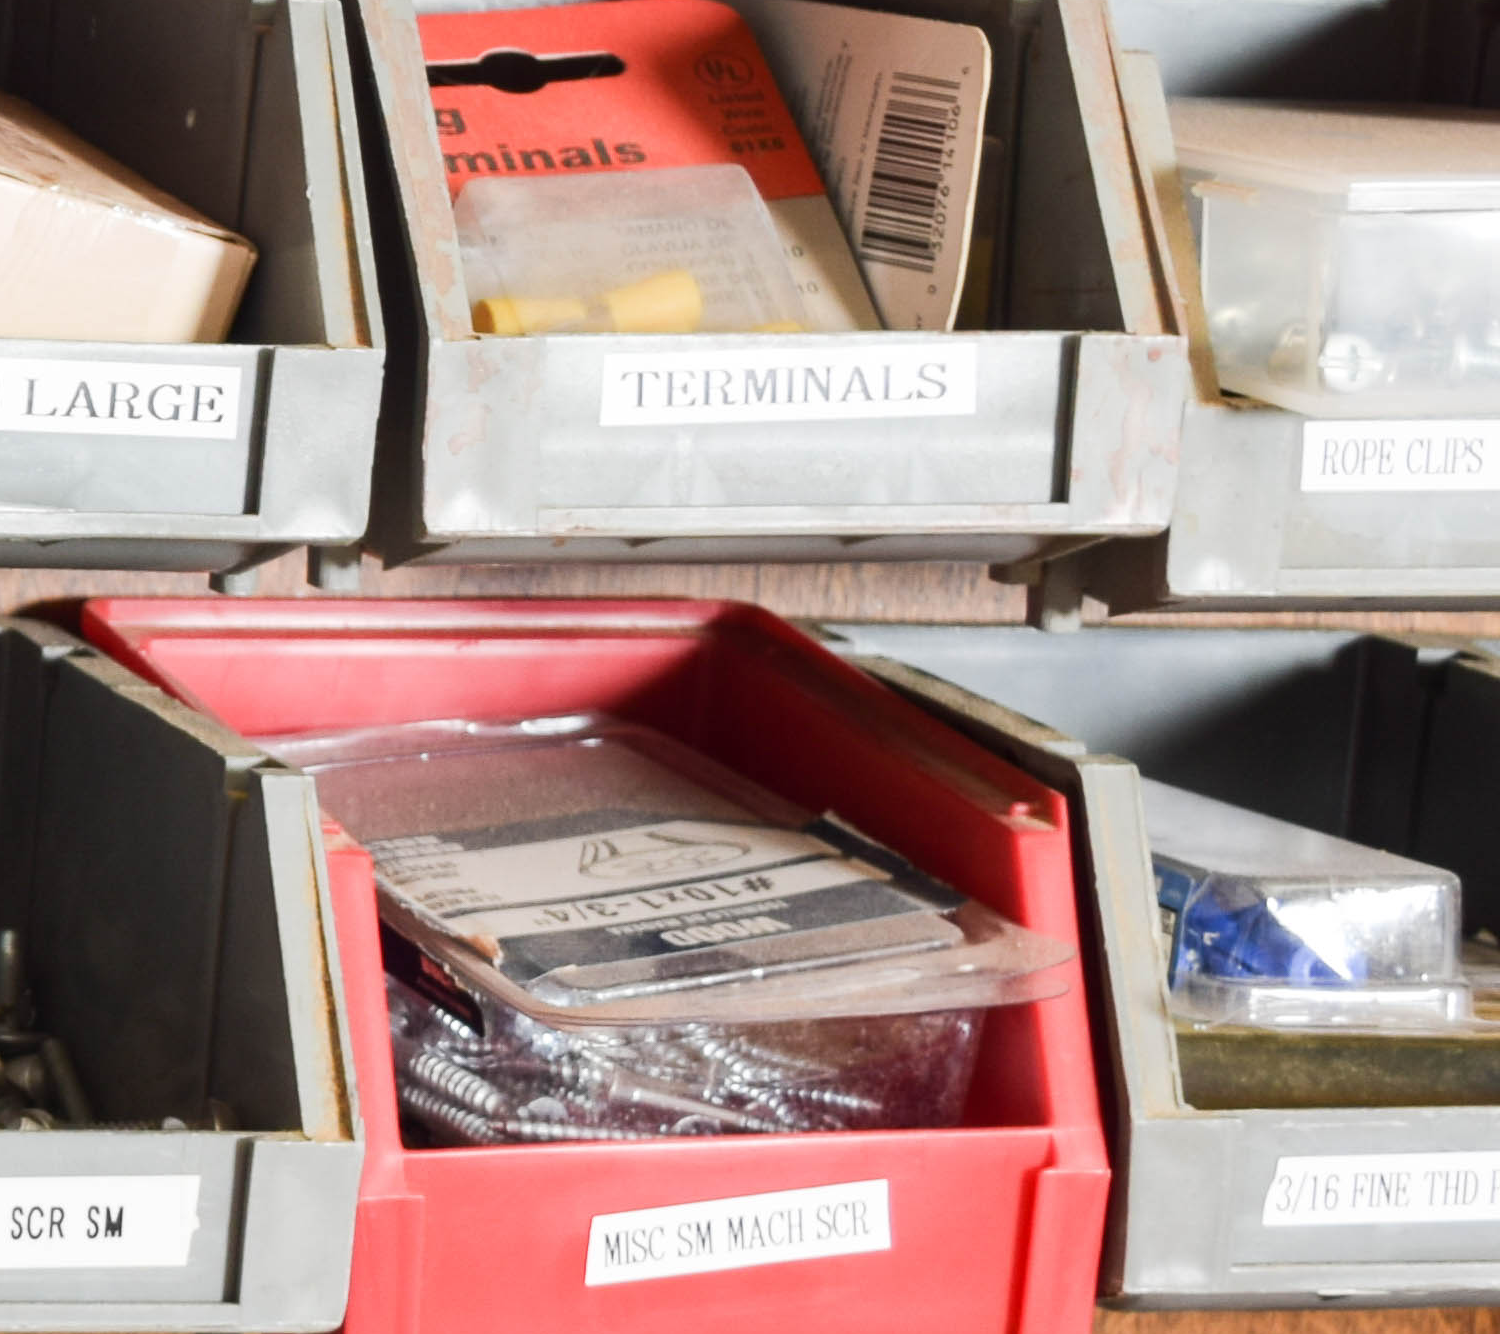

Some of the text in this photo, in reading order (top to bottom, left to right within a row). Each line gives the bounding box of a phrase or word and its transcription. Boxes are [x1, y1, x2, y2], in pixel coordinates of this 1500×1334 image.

[25, 378, 224, 423] LARGE
[620, 363, 948, 408] TERMINALS
[1320, 437, 1485, 476] ROPE CLIPS
[660, 916, 792, 947] WOOD
[1352, 1172, 1411, 1208] FINE
[1423, 1170, 1480, 1207] THD
[10, 1205, 65, 1241] SCR
[86, 1205, 124, 1240] SM
[604, 1201, 870, 1266] MISC SM MACH SCR
